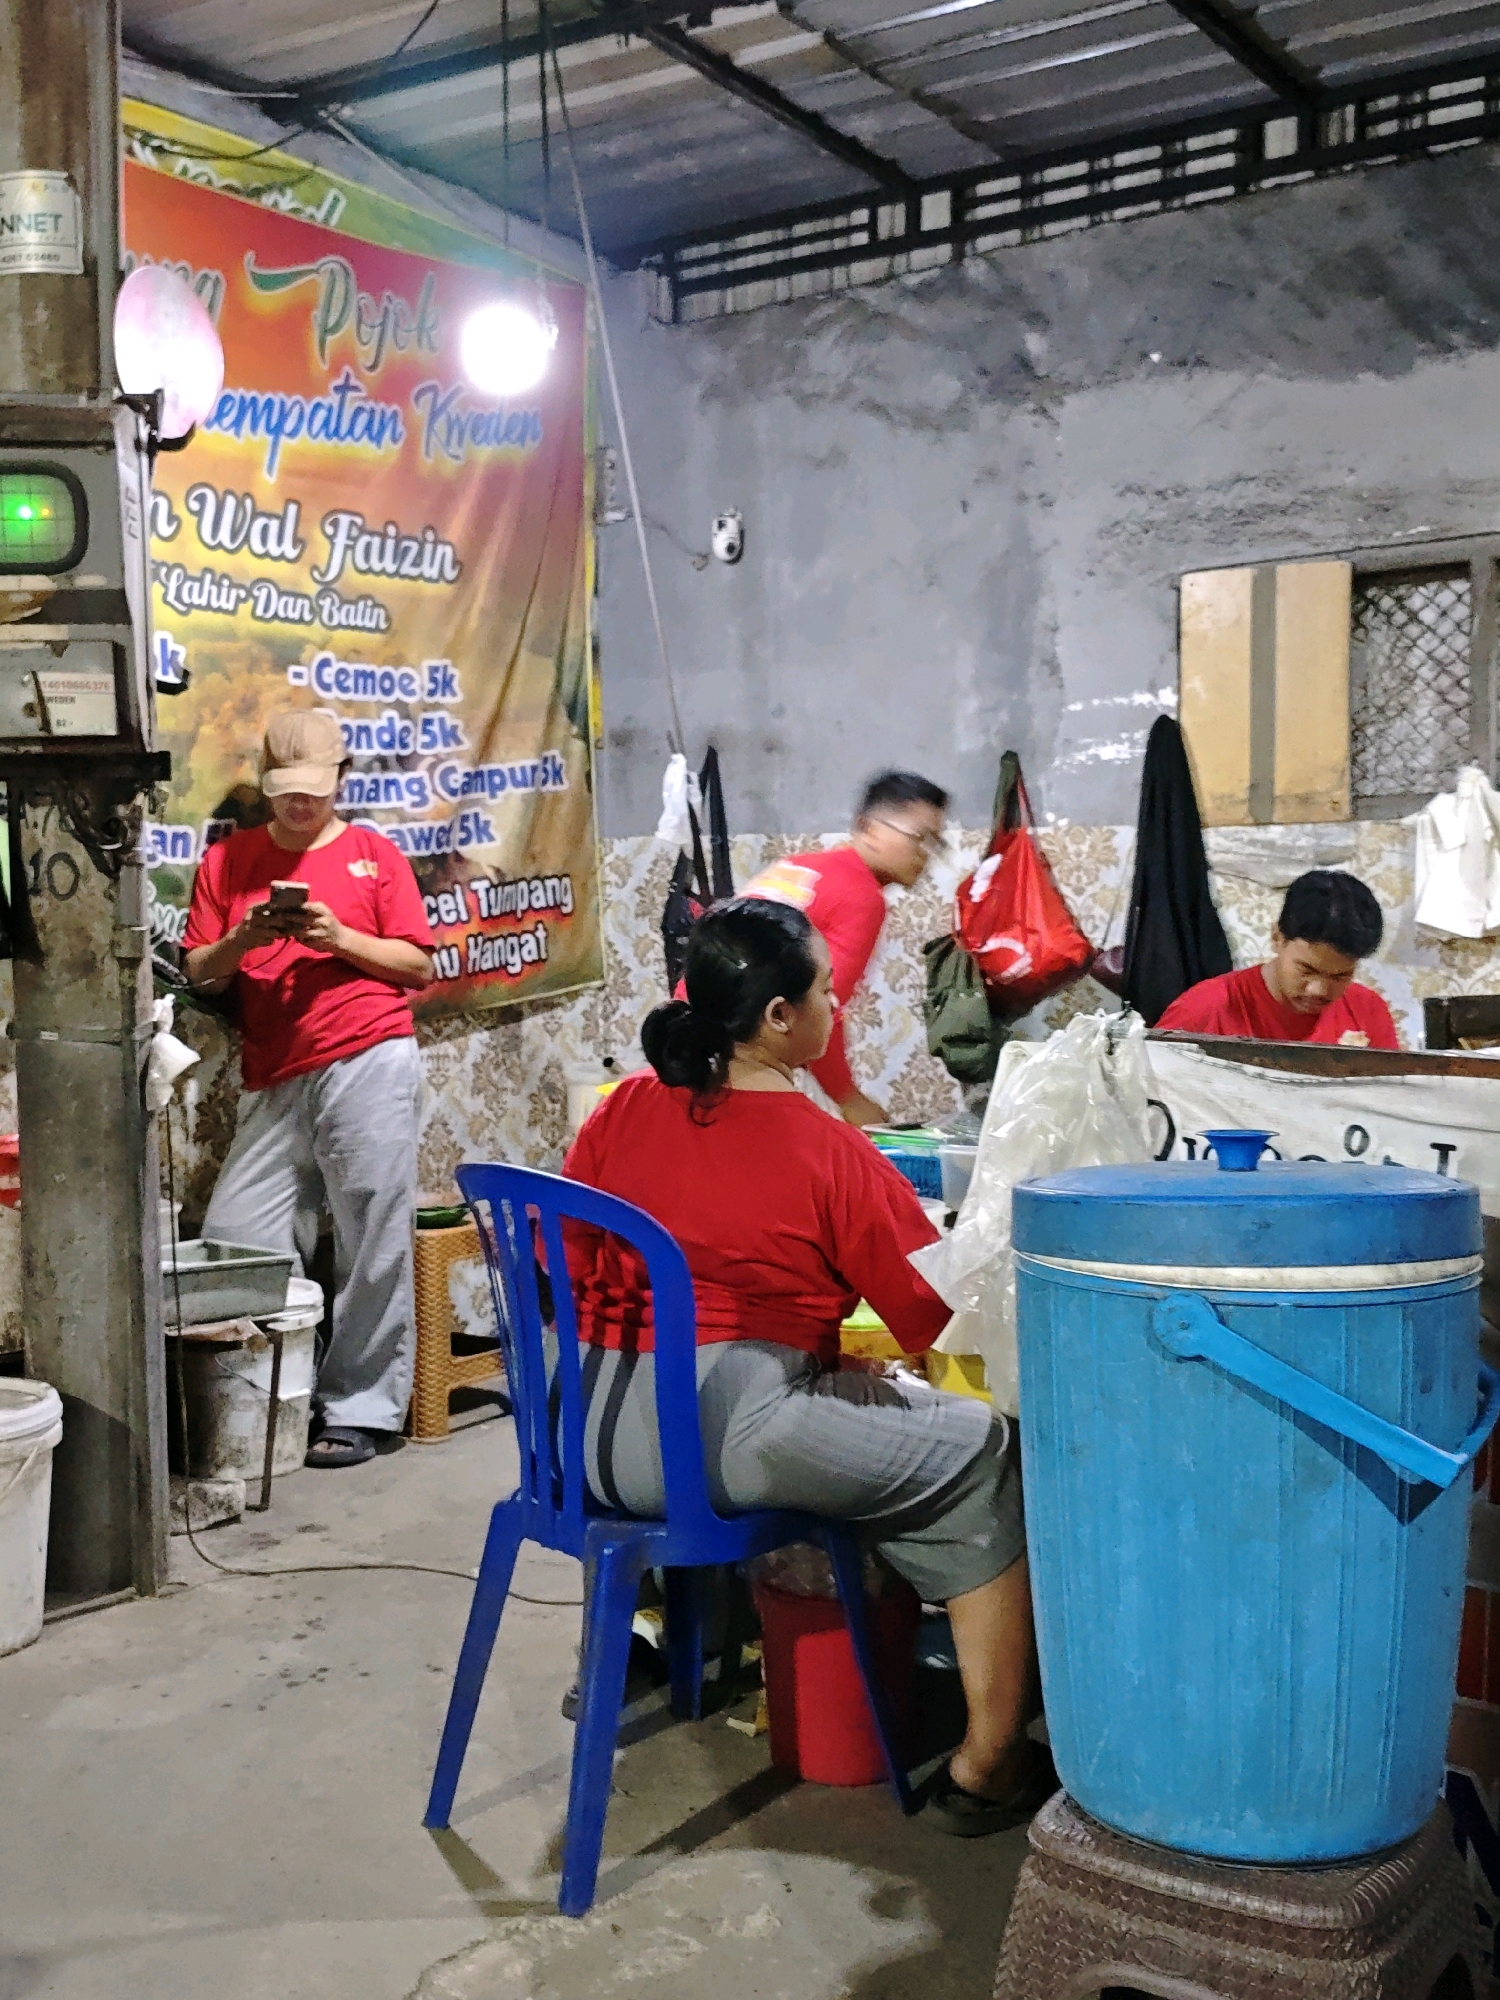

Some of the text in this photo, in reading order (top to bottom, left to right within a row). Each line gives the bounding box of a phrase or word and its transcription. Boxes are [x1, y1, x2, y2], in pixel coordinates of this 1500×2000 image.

[245, 250, 439, 372] Pojok
[205, 368, 402, 479] empatan
[187, 486, 302, 560] Wal
[311, 512, 461, 583] Faizin
[160, 566, 247, 613] Lahir
[251, 582, 313, 623] Dan
[427, 664, 457, 698] 5k
[340, 716, 465, 751] onde 5k
[345, 773, 430, 809] nang
[384, 811, 498, 852] awe 5k
[423, 876, 574, 927] cel Tumpang
[467, 921, 549, 976] Hangat
